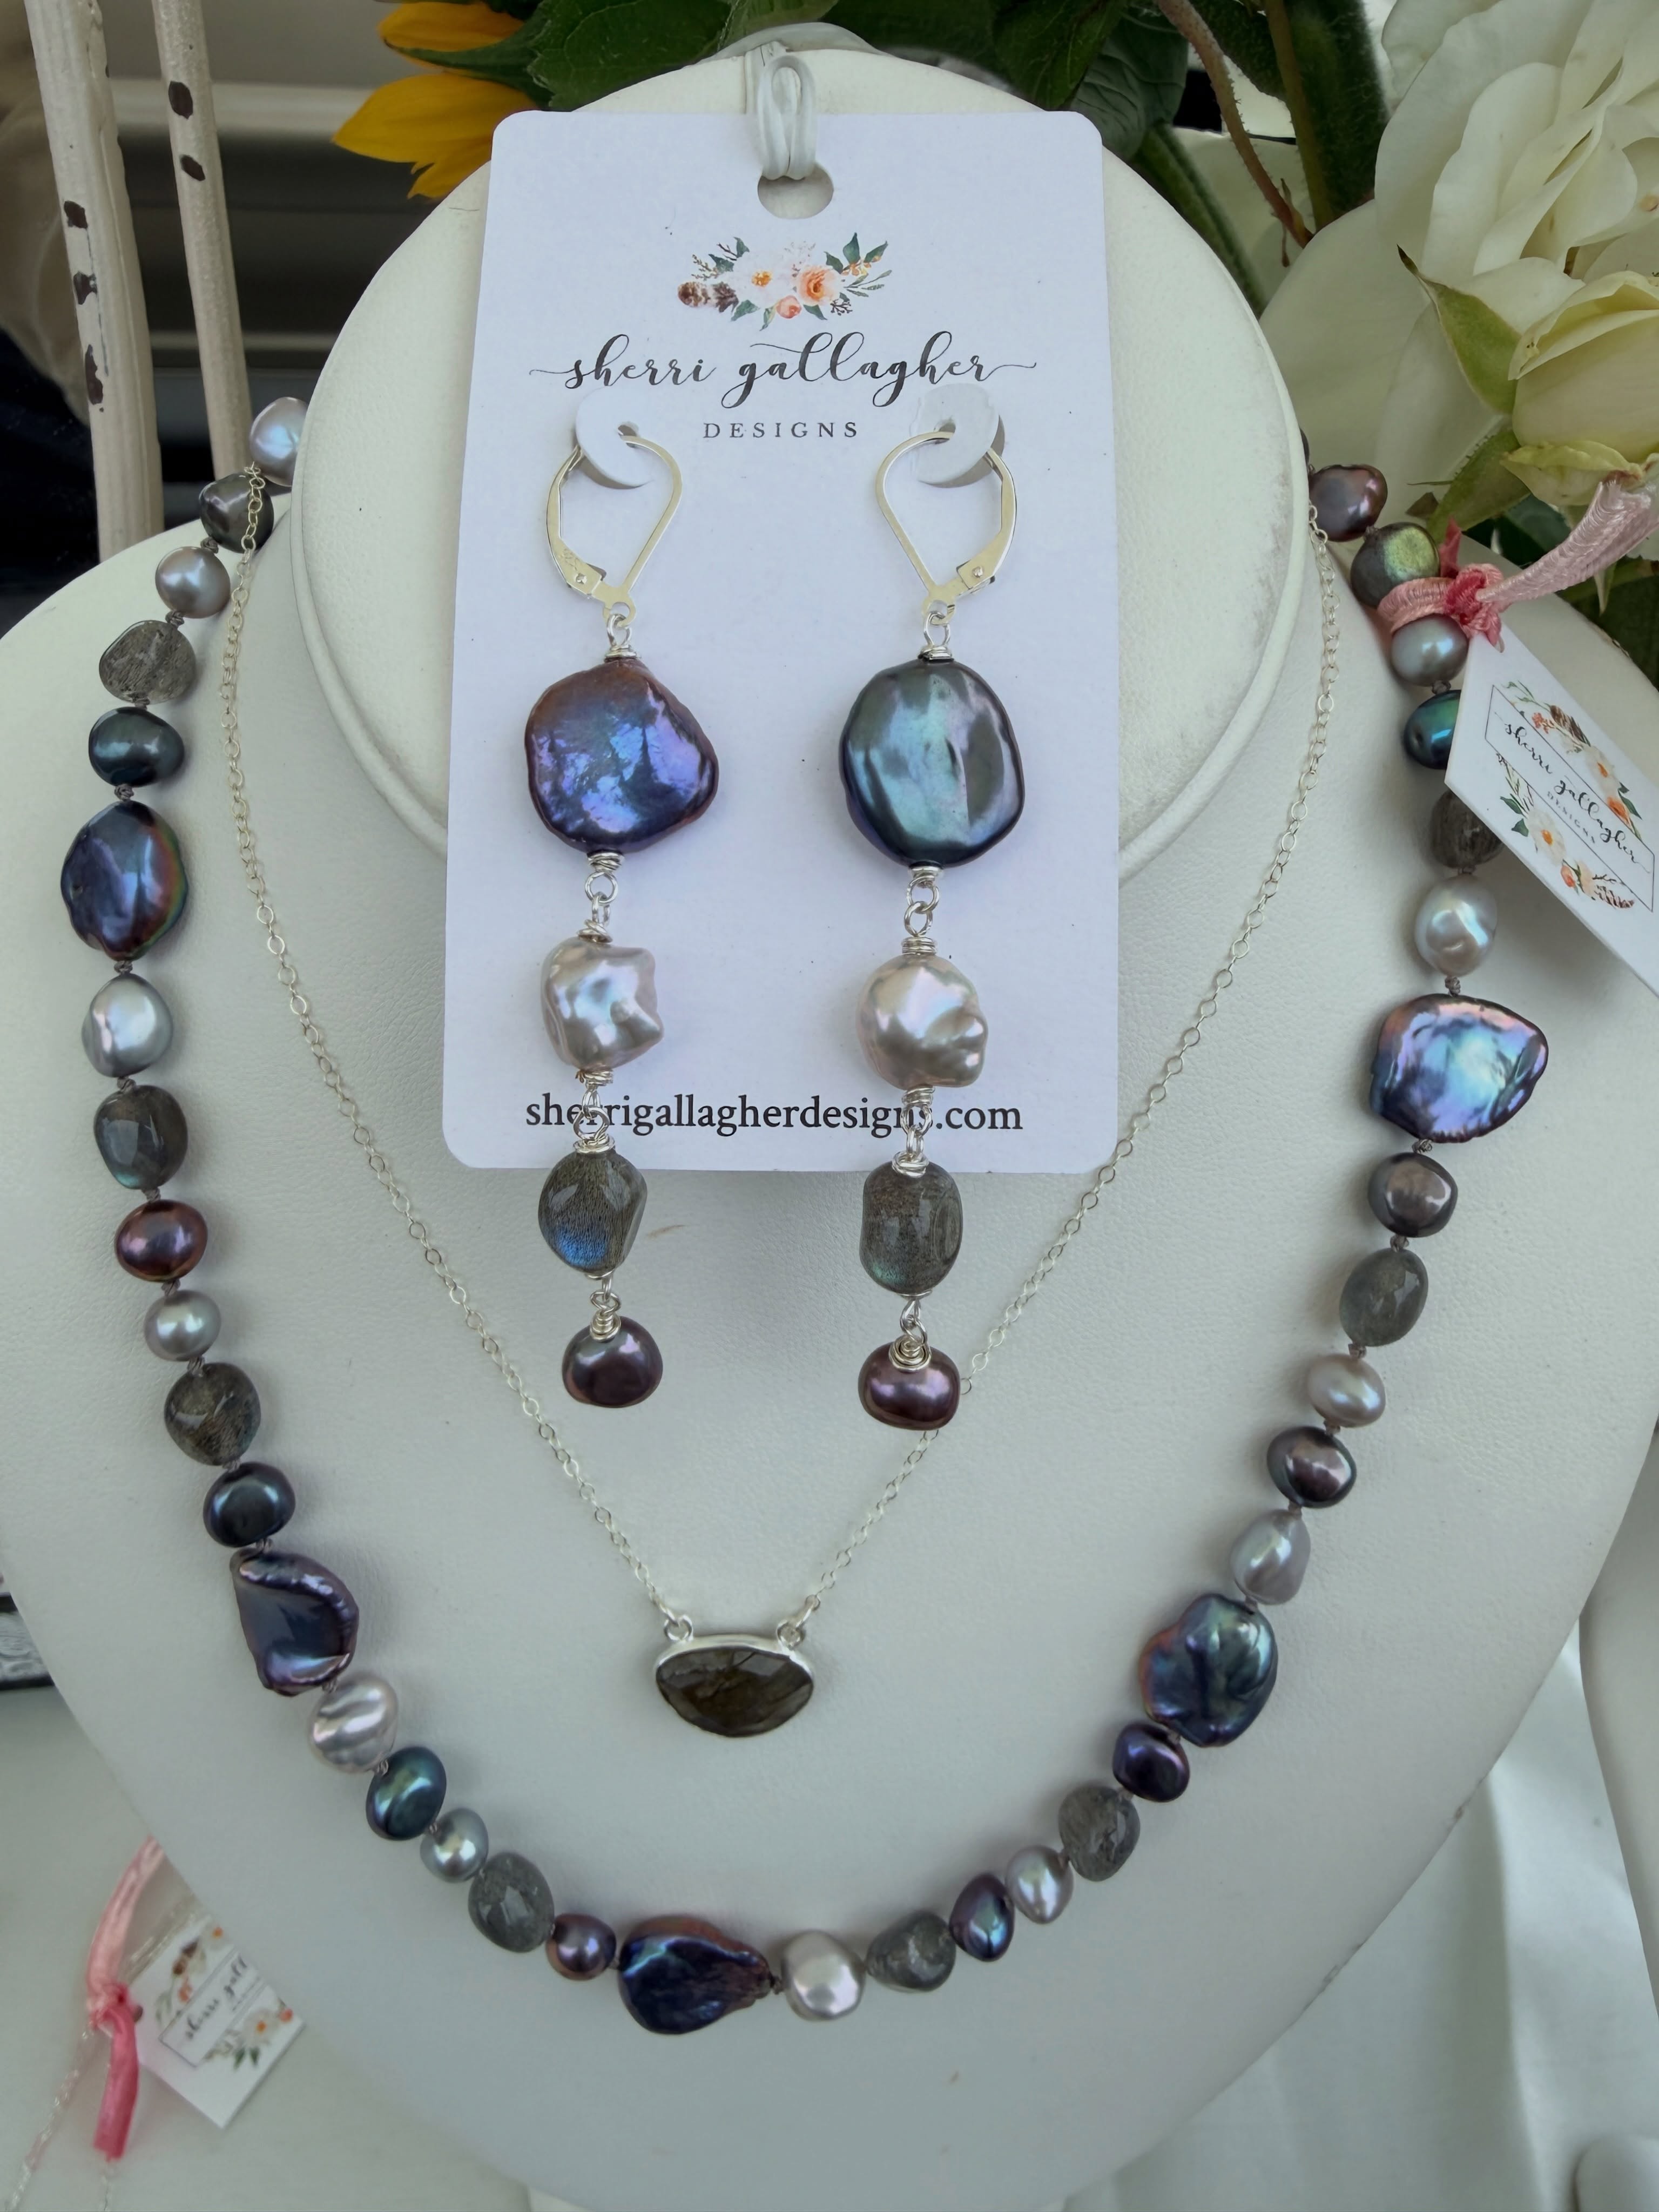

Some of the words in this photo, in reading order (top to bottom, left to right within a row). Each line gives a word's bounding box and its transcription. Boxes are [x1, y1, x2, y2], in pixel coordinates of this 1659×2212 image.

[529, 333, 718, 389] sherri
[720, 331, 1037, 409] gallagher
[703, 421, 860, 439] DESIGNS
[1554, 774, 1650, 874] gallagher
